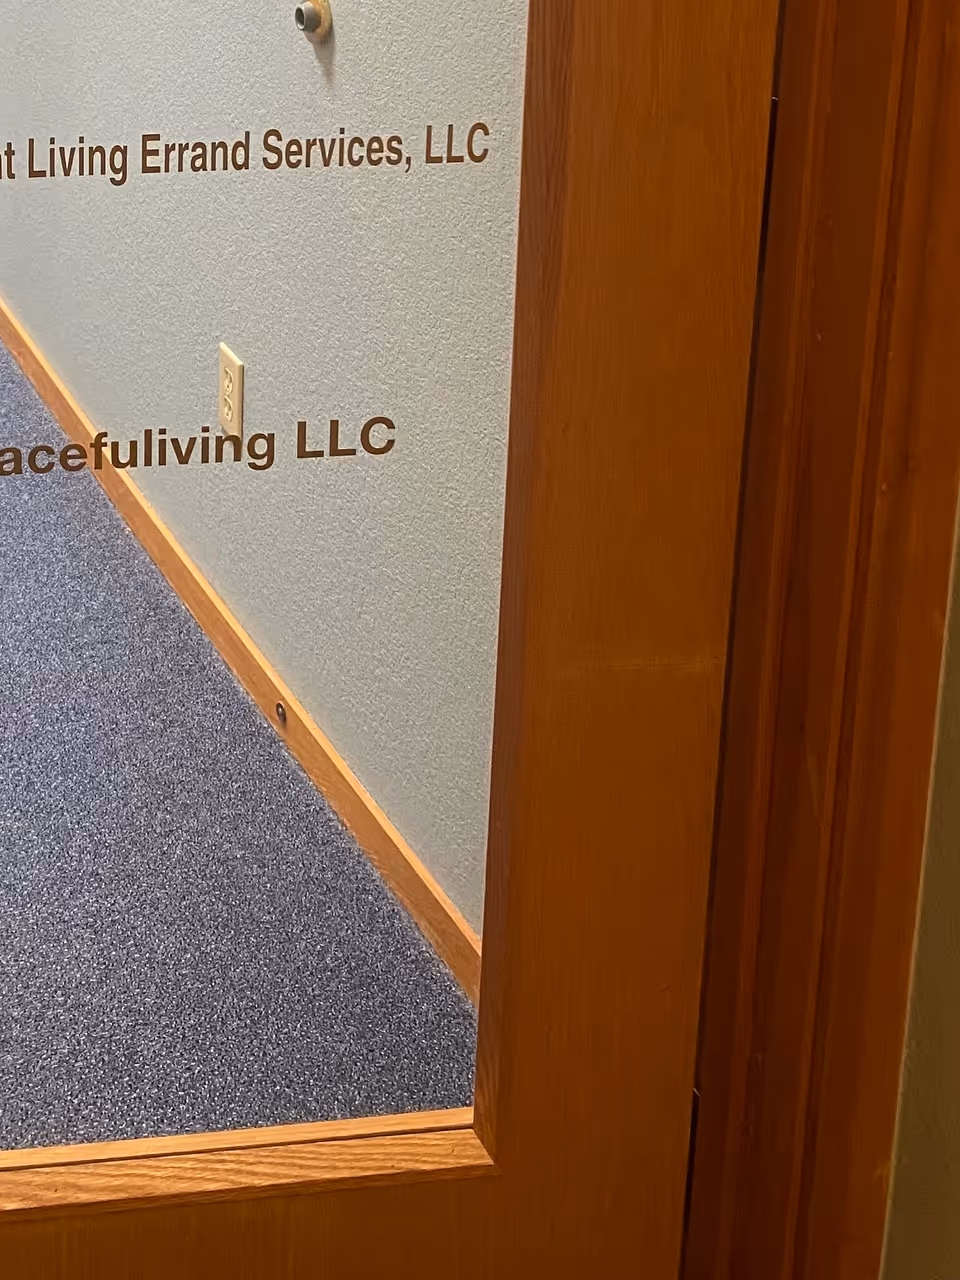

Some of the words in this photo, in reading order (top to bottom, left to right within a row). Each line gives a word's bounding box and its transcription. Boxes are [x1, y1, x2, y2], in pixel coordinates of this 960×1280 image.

[27, 136, 128, 186] Living
[141, 131, 250, 173] Errand
[262, 128, 412, 173] Services,
[425, 122, 490, 164] LLC
[296, 416, 396, 459] LLC
